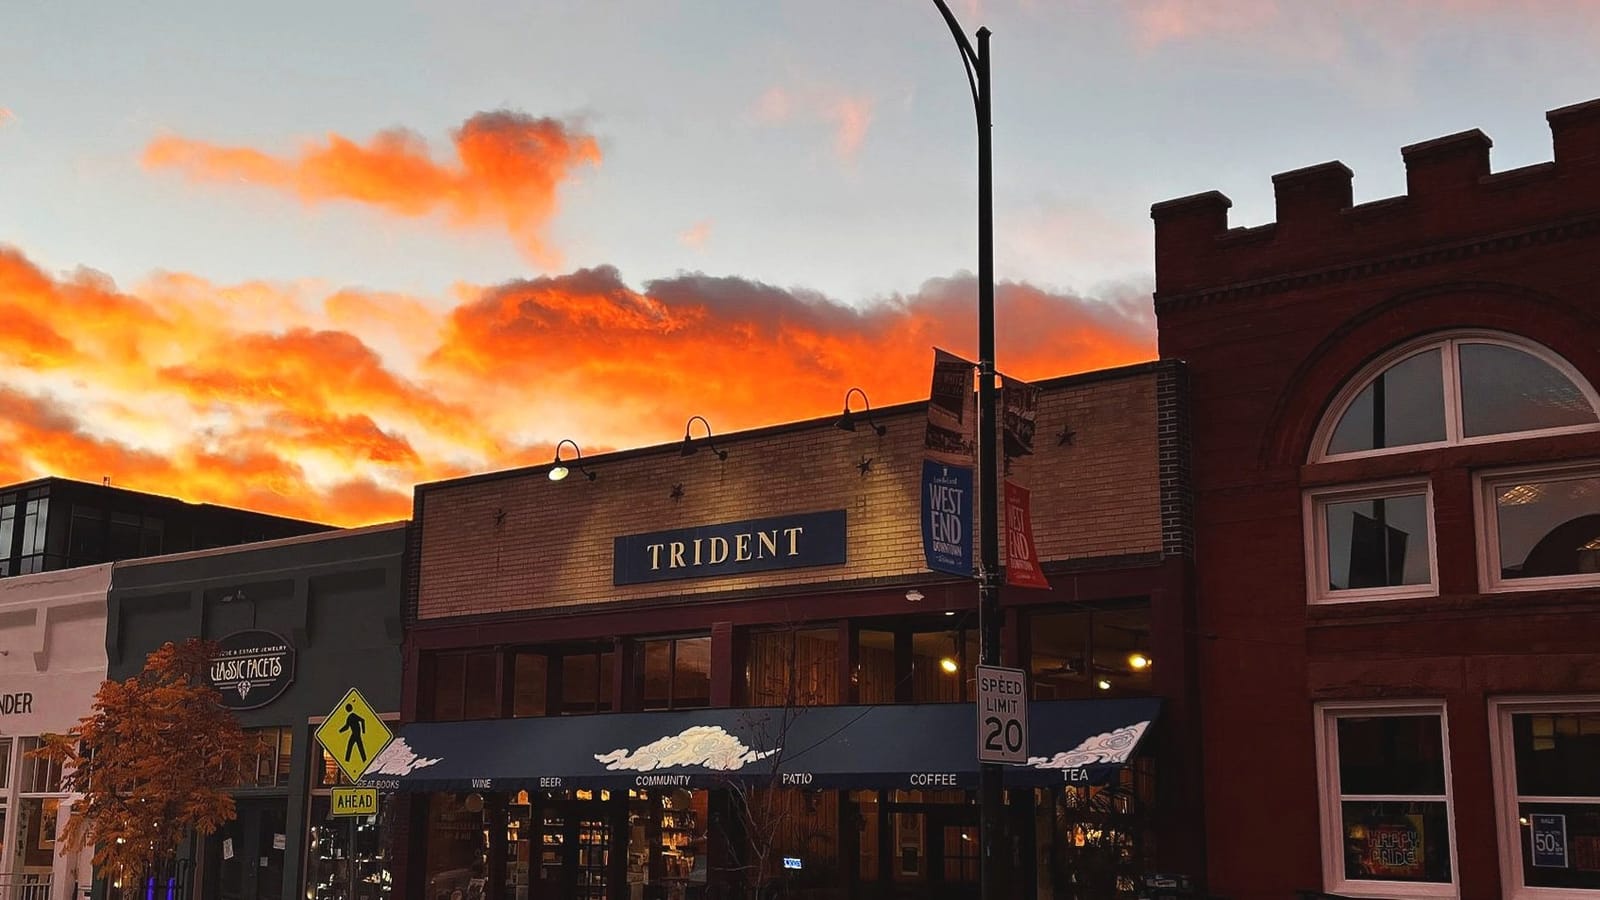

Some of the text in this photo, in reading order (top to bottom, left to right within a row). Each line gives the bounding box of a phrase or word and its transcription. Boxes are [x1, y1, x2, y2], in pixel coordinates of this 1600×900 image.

[929, 483, 963, 515] WEST
[1008, 504, 1024, 533] WEST
[931, 511, 961, 544] END
[647, 527, 803, 570] TRIDENT
[933, 541, 962, 557] DOWNTOWN
[1010, 530, 1029, 560] END
[239, 647, 258, 655] ESTATE
[260, 645, 287, 653] JEWELRY
[211, 657, 282, 681] CLASSIC FACETS
[981, 676, 1022, 695] SPEED
[986, 698, 1018, 713] LIMIT
[985, 717, 1023, 752] 20
[540, 777, 562, 788] BEER
[635, 775, 691, 787] COMMUNITY
[782, 773, 813, 785] PATIO
[910, 773, 957, 786] COFFEE
[1062, 769, 1089, 781] TEA
[376, 779, 400, 789] BOOKS
[472, 778, 493, 789] WINE
[338, 795, 372, 808] AHEAD
[1367, 830, 1418, 848] HAPPY
[1369, 847, 1418, 866] PRIDE
